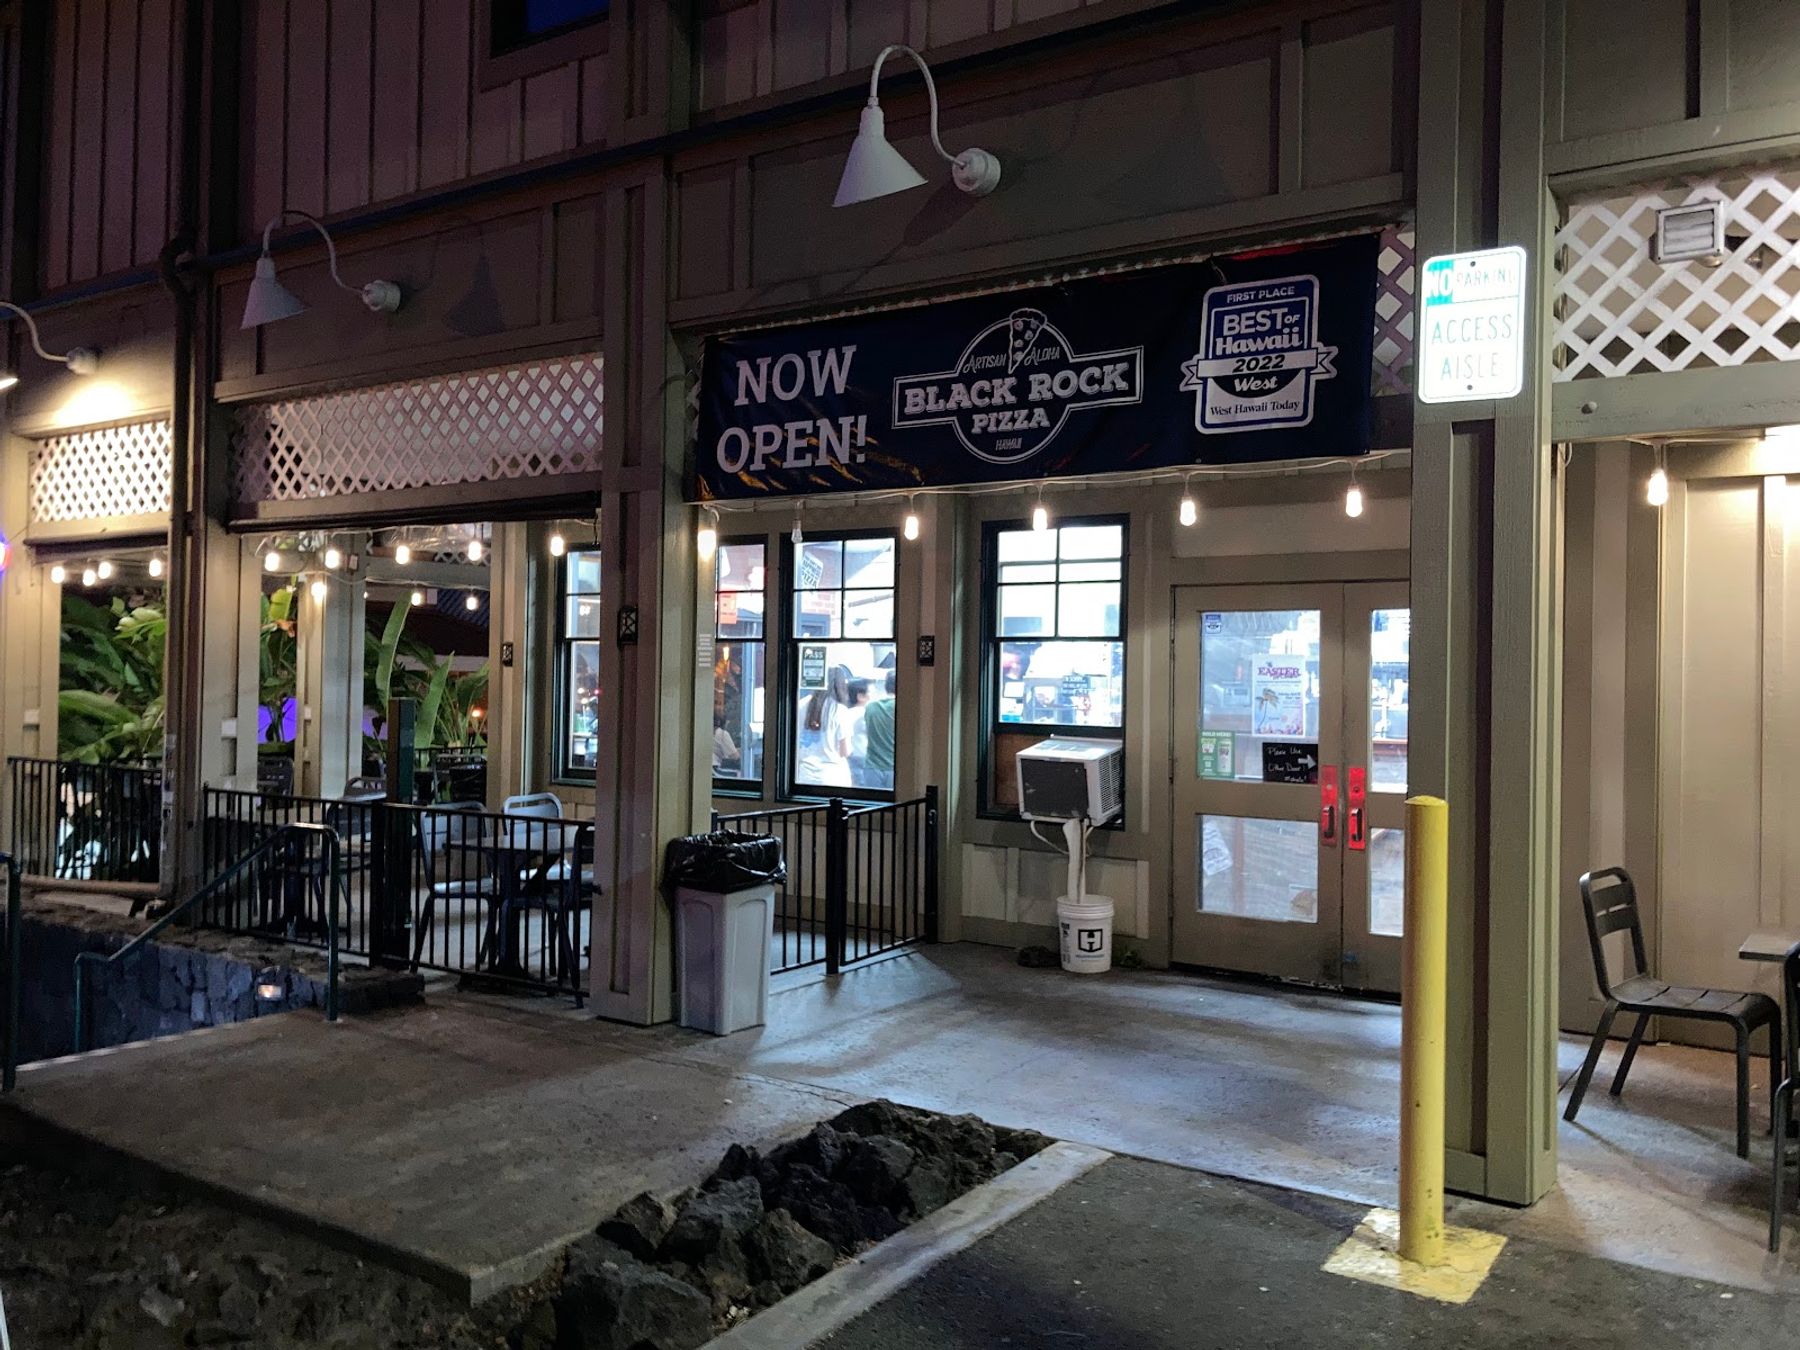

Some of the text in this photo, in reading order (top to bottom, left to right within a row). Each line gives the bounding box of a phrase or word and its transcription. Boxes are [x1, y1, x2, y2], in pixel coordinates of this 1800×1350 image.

[1226, 286, 1295, 304] FIRST PLACE
[1222, 307, 1301, 337] BEST OF
[1431, 314, 1513, 345] ACCESS
[1215, 327, 1303, 356] Hawaii
[963, 346, 1061, 373] ARTISAN ALOHA
[1231, 354, 1286, 374] 2022
[1440, 353, 1499, 381] AISLE
[734, 345, 857, 408] NOW
[904, 362, 1130, 416] BLACK ROCK
[1233, 375, 1279, 392] West
[971, 407, 1051, 434] PIZZA
[1210, 400, 1300, 416] West Hawaii Today
[716, 414, 867, 474] OPEN!
[995, 437, 1023, 450] HAWAII
[1257, 667, 1301, 678] EASTER
